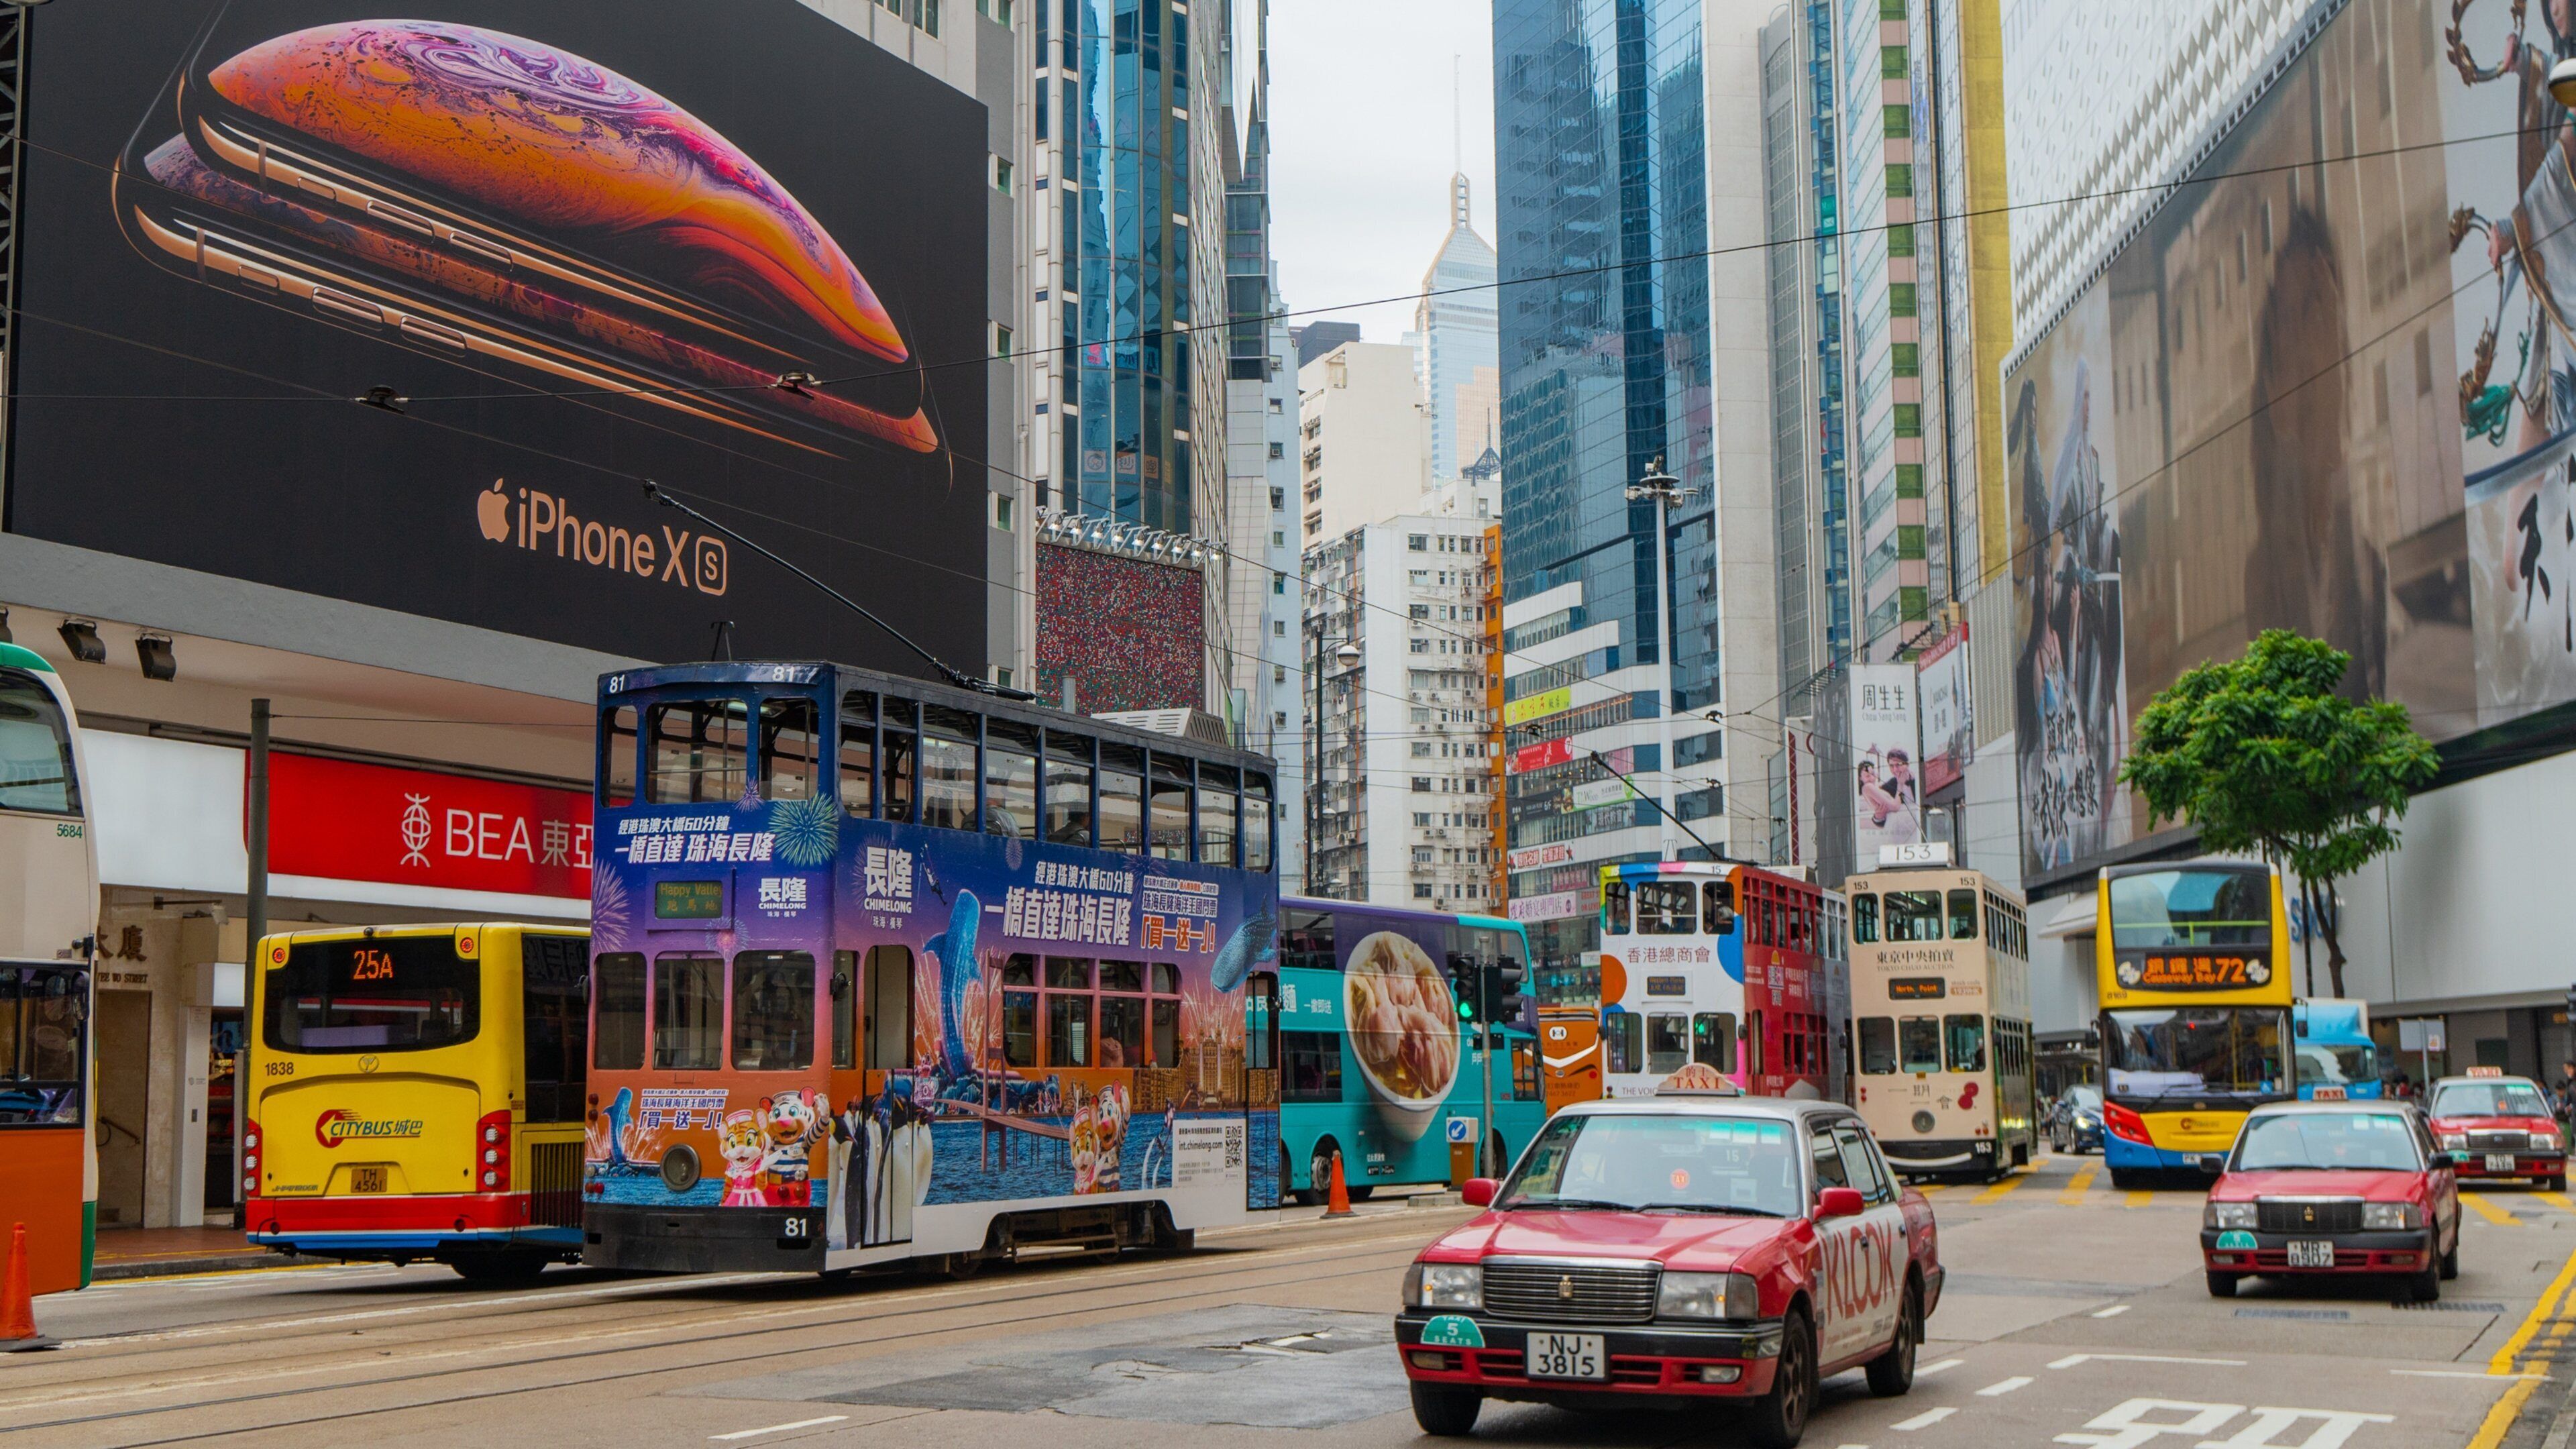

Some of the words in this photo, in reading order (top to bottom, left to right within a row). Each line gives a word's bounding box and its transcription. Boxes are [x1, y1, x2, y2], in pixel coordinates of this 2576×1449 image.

[518, 487, 655, 577] iPhone
[661, 525, 690, 587] X
[772, 666, 795, 683] 81
[609, 674, 625, 694] 81
[1862, 684, 1906, 710] 周生生
[1862, 713, 1878, 721] Chow
[1878, 713, 1892, 722] Sang
[1892, 713, 1907, 722] Sang
[56, 823, 83, 839] 5684
[617, 815, 731, 835] 經港珠澳大橋60分鐘
[445, 808, 535, 864] BEA
[614, 835, 684, 863] 一橋直達
[684, 833, 776, 862] 珠海長隆
[1895, 844, 1932, 861] 153
[863, 846, 912, 898] 長隆
[1034, 861, 1134, 895] 經港珠澳大橋60分鐘
[1711, 865, 1722, 875] 15
[757, 876, 807, 903] 長隆
[1853, 880, 1869, 891] 153
[1960, 877, 1976, 886] 153
[660, 883, 692, 898] Happy
[757, 902, 807, 910] CHIMELONG
[863, 898, 912, 914] CHIMELONG
[984, 885, 1133, 947] 一橋直達珠海長隆
[1627, 945, 1711, 964] 香港總商會
[1876, 949, 1954, 964] 東京中央拍賣
[352, 948, 394, 980] 25A
[2215, 957, 2247, 983] 72
[123, 973, 148, 983] STREET
[1919, 984, 1938, 993] Point
[264, 1061, 295, 1077] 1838
[1622, 1087, 1637, 1095] THE
[1674, 1077, 1721, 1089] TAXI
[2316, 1087, 2346, 1101] TAXI
[330, 1120, 394, 1137] CITYBUS
[394, 1119, 423, 1136] 城巴
[1178, 1139, 1224, 1152] int.chimelong.com
[1975, 1142, 1992, 1154] 153
[361, 1169, 378, 1179] TH
[354, 1179, 383, 1192] 4561
[785, 1217, 807, 1237] 81
[1820, 1218, 1896, 1326] KLOOK
[1446, 1322, 1459, 1336] 5
[1434, 1335, 1472, 1346] SEATS
[1550, 1334, 1581, 1355] NJ
[1537, 1354, 1595, 1376] 3815
